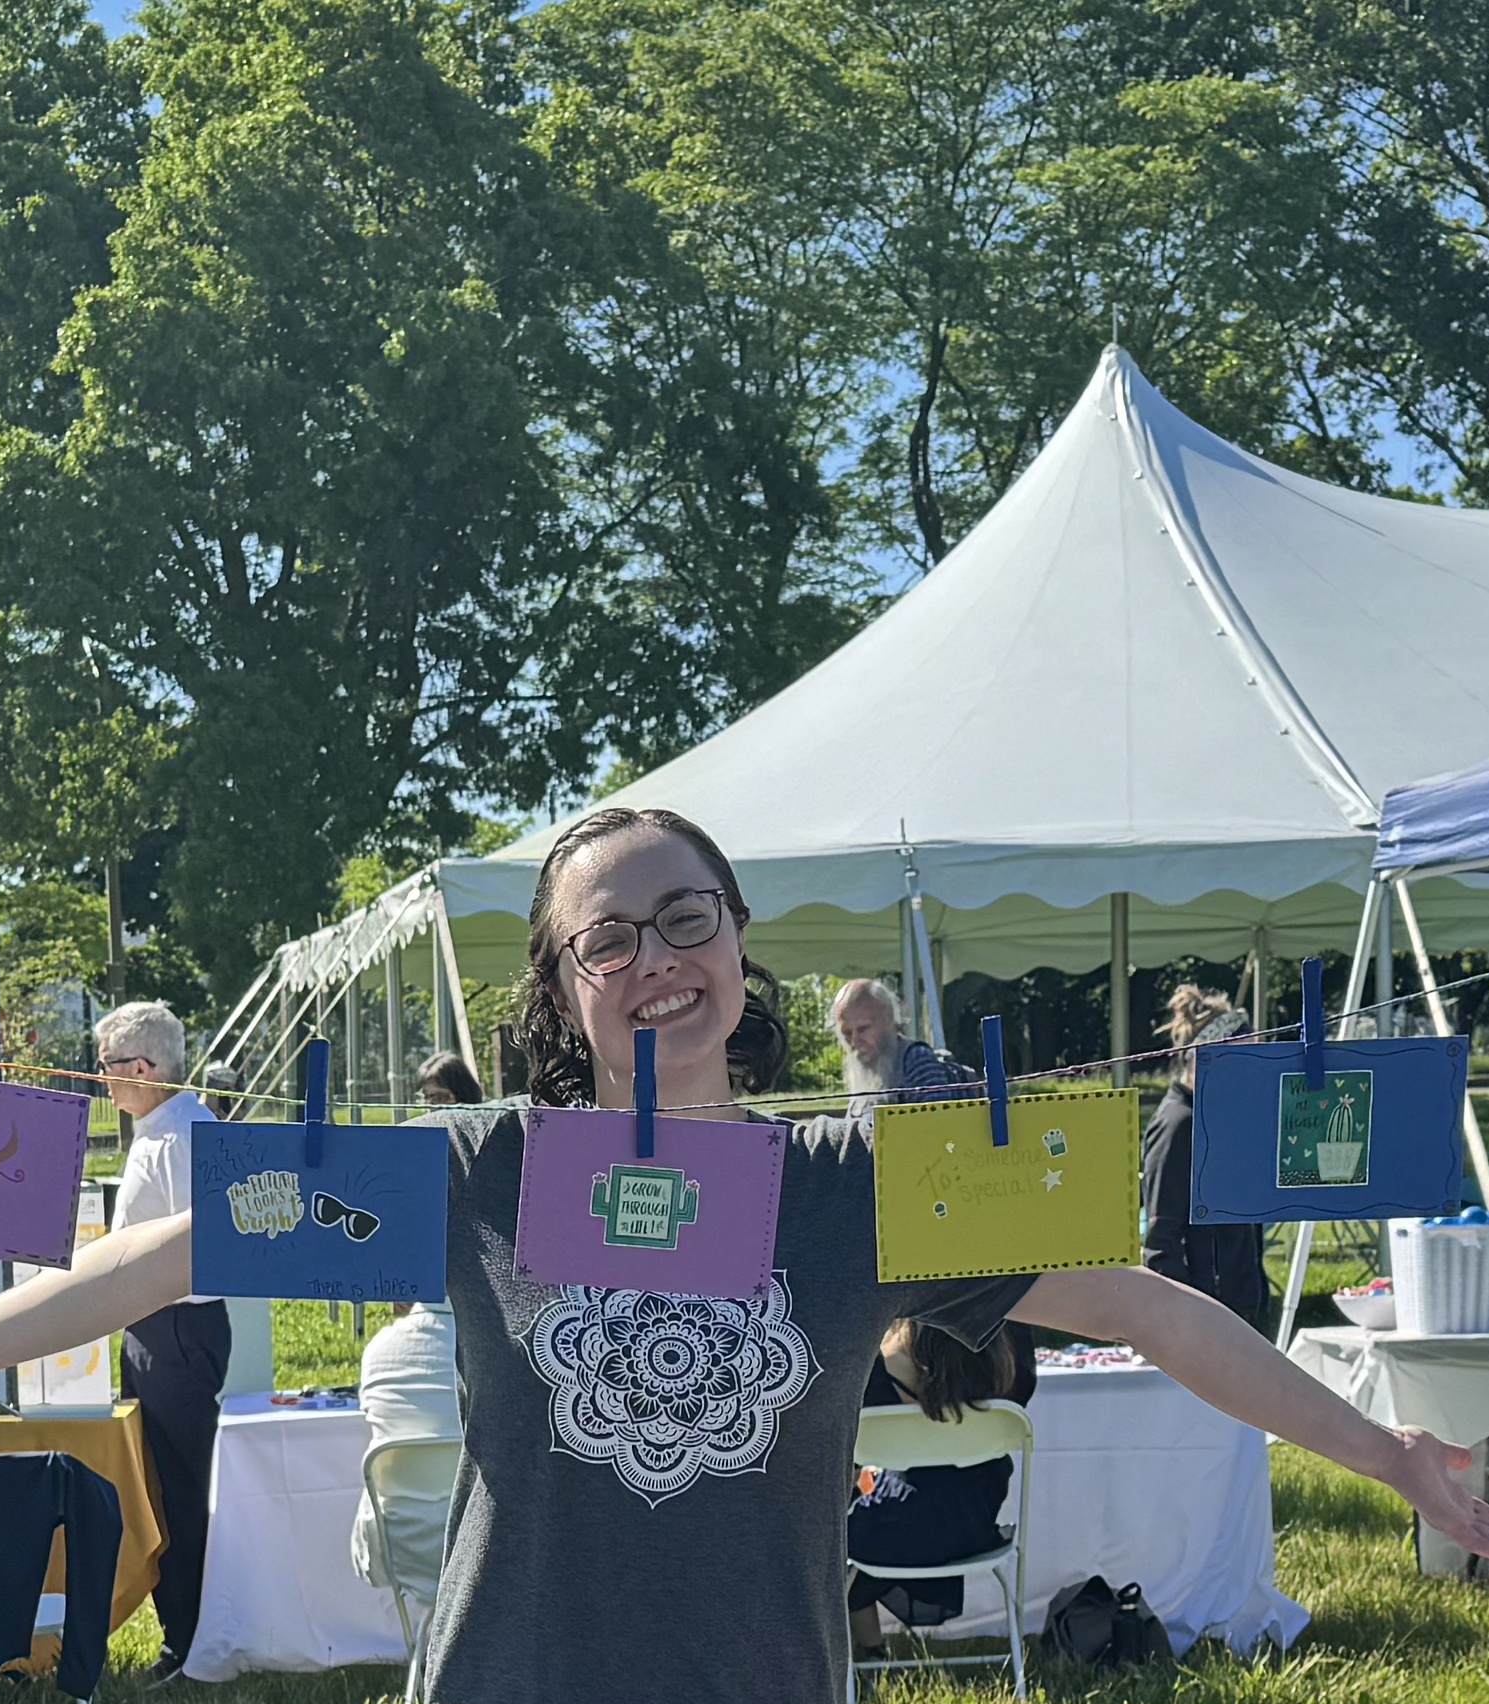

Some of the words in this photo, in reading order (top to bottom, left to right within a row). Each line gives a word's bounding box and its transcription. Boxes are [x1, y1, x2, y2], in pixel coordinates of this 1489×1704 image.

[250, 1172, 299, 1195] FUTURE
[917, 1158, 961, 1199] To:
[233, 1195, 302, 1237] bright
